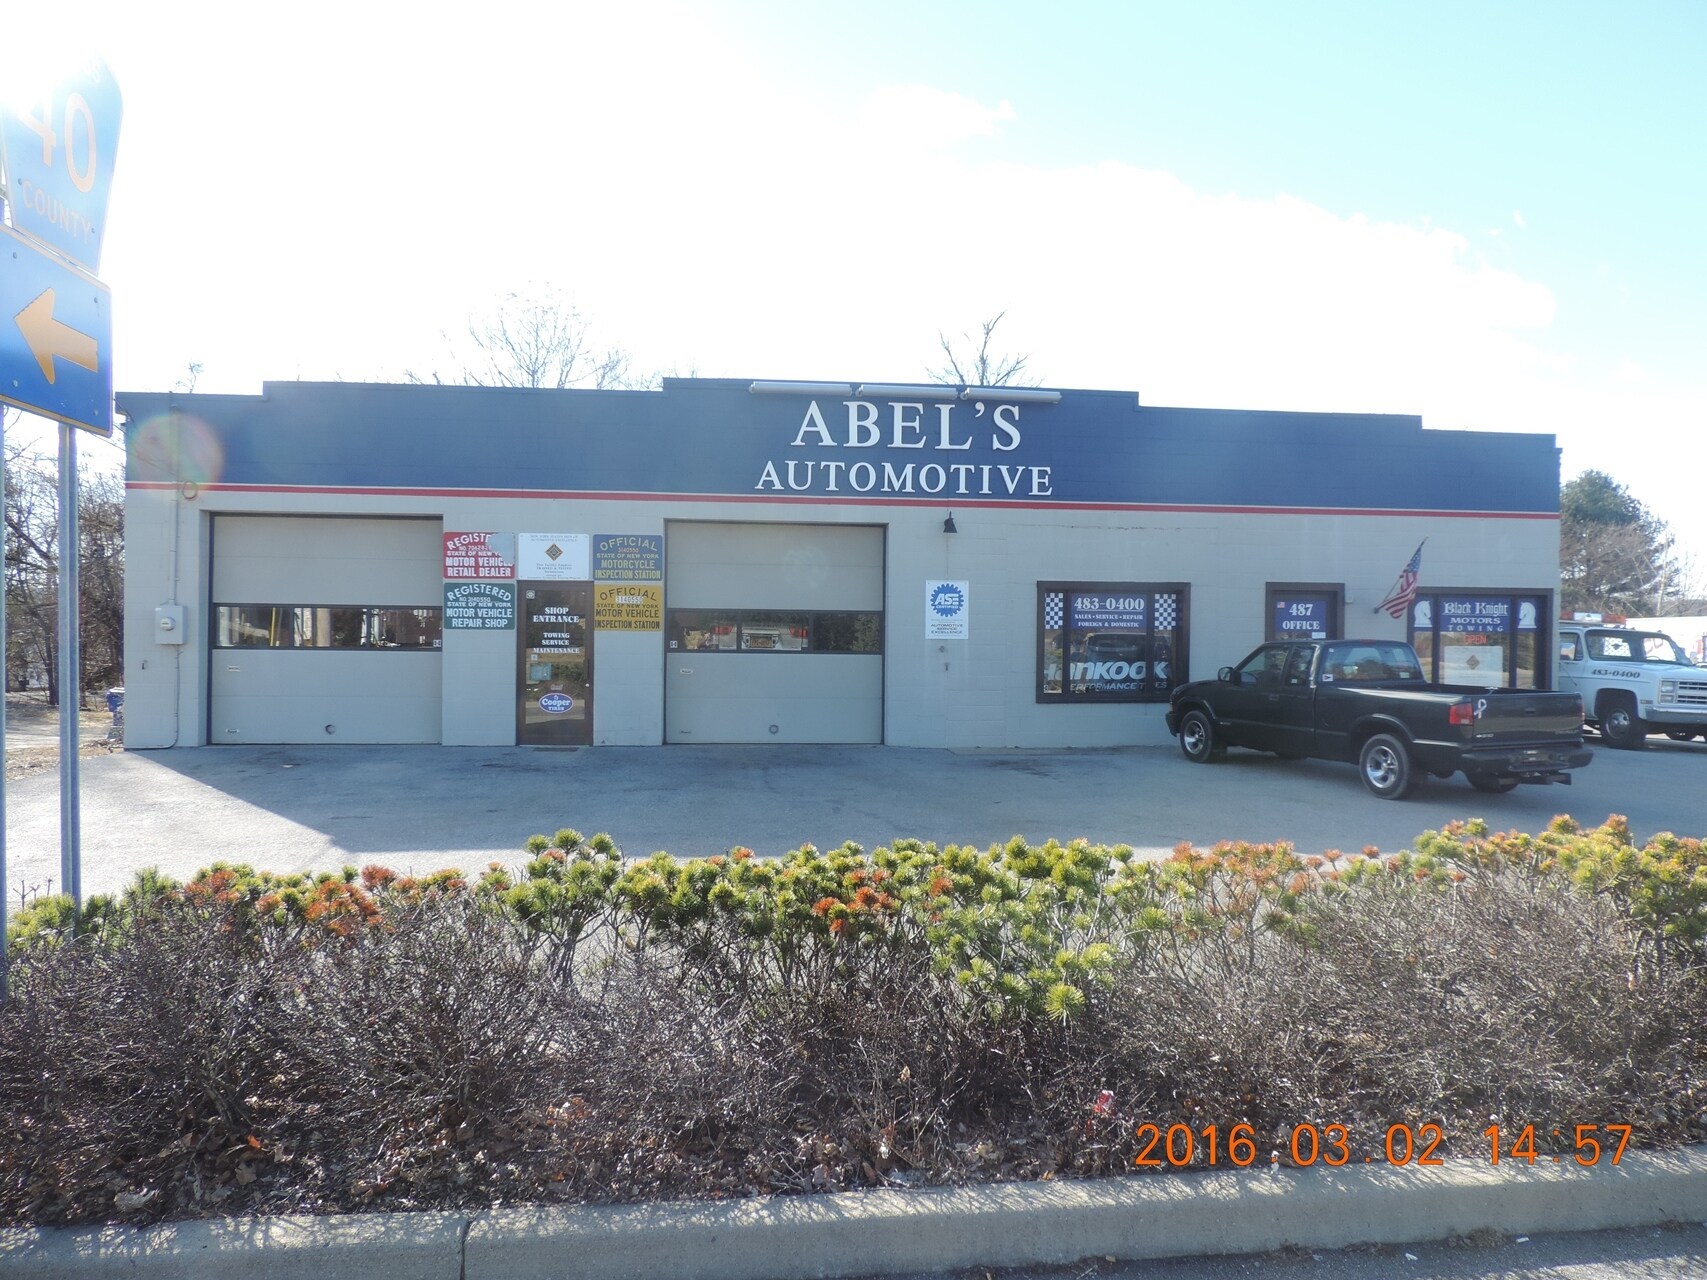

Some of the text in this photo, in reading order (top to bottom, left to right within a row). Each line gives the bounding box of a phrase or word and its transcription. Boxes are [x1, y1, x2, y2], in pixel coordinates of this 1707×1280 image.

[18, 92, 97, 193] 40
[22, 179, 91, 244] COUNTY
[791, 400, 1021, 450] ABEL'S
[754, 460, 1053, 495] AUTOMOTIVE
[447, 533, 491, 550] REGIST
[600, 537, 658, 551] OFFICIAL
[445, 557, 475, 566] MOTOR
[601, 560, 655, 569] MOTORCYCLE
[447, 567, 511, 577] RETAIL DEALER
[595, 570, 661, 579] INSPECTION STATION
[447, 584, 512, 601] REGISTERED
[600, 587, 657, 602] OFFICIAL
[934, 593, 959, 605] ASE
[1074, 597, 1145, 610] 483-0400
[446, 608, 512, 617] MOTOR VEHICLE
[545, 607, 569, 615] SHOP
[596, 609, 659, 618] MOTOR VEHICLE
[1289, 603, 1314, 616] 487
[1443, 602, 1509, 617] Black Knight
[452, 618, 508, 628] REPAIR SHOP
[533, 615, 580, 623] ENTRANCE
[594, 620, 660, 629] INSPECTION STATION
[1282, 620, 1321, 630] OFFICE
[1447, 624, 1504, 632] TOWING
[1464, 634, 1488, 644] OPEN
[1070, 682, 1138, 690] ERFORMANCE
[541, 698, 571, 707] Cooper
